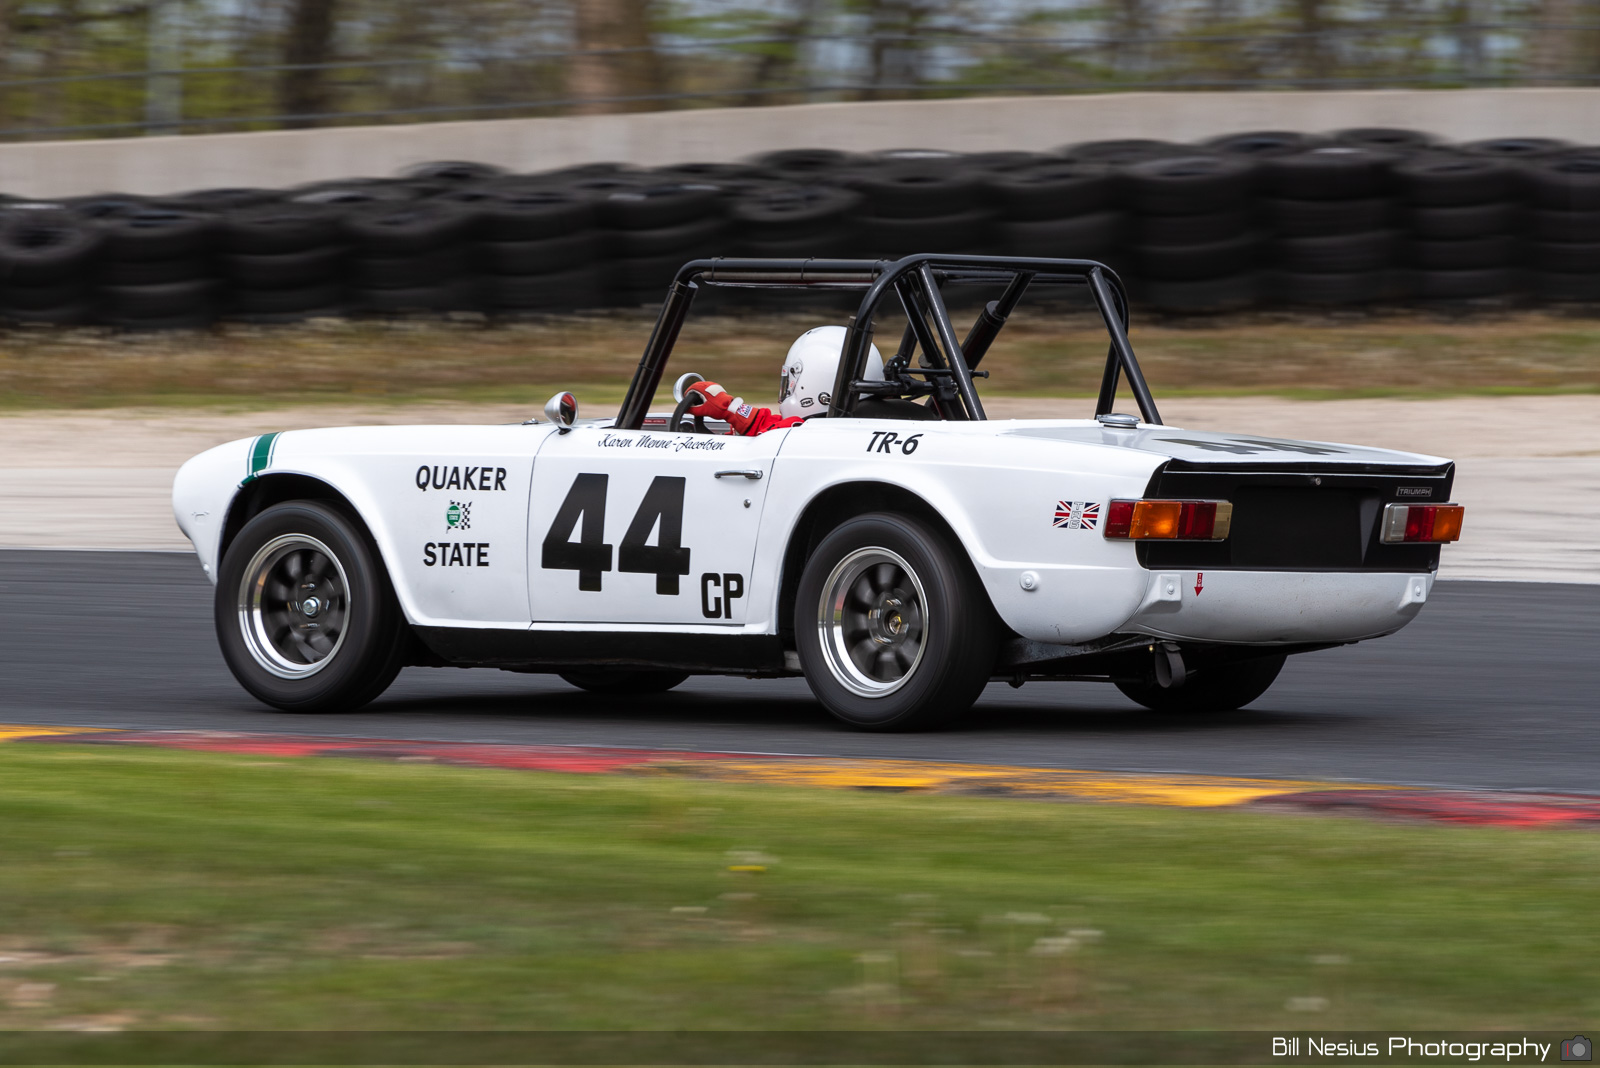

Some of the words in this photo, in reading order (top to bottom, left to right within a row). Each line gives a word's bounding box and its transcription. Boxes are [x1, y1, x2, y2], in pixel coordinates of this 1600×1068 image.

[598, 434, 633, 448] Karen
[866, 431, 924, 455] TR-6
[416, 465, 507, 491] QUAKER
[1399, 488, 1431, 496] TRIUMPH
[541, 473, 691, 596] 44
[423, 542, 490, 567] STATE
